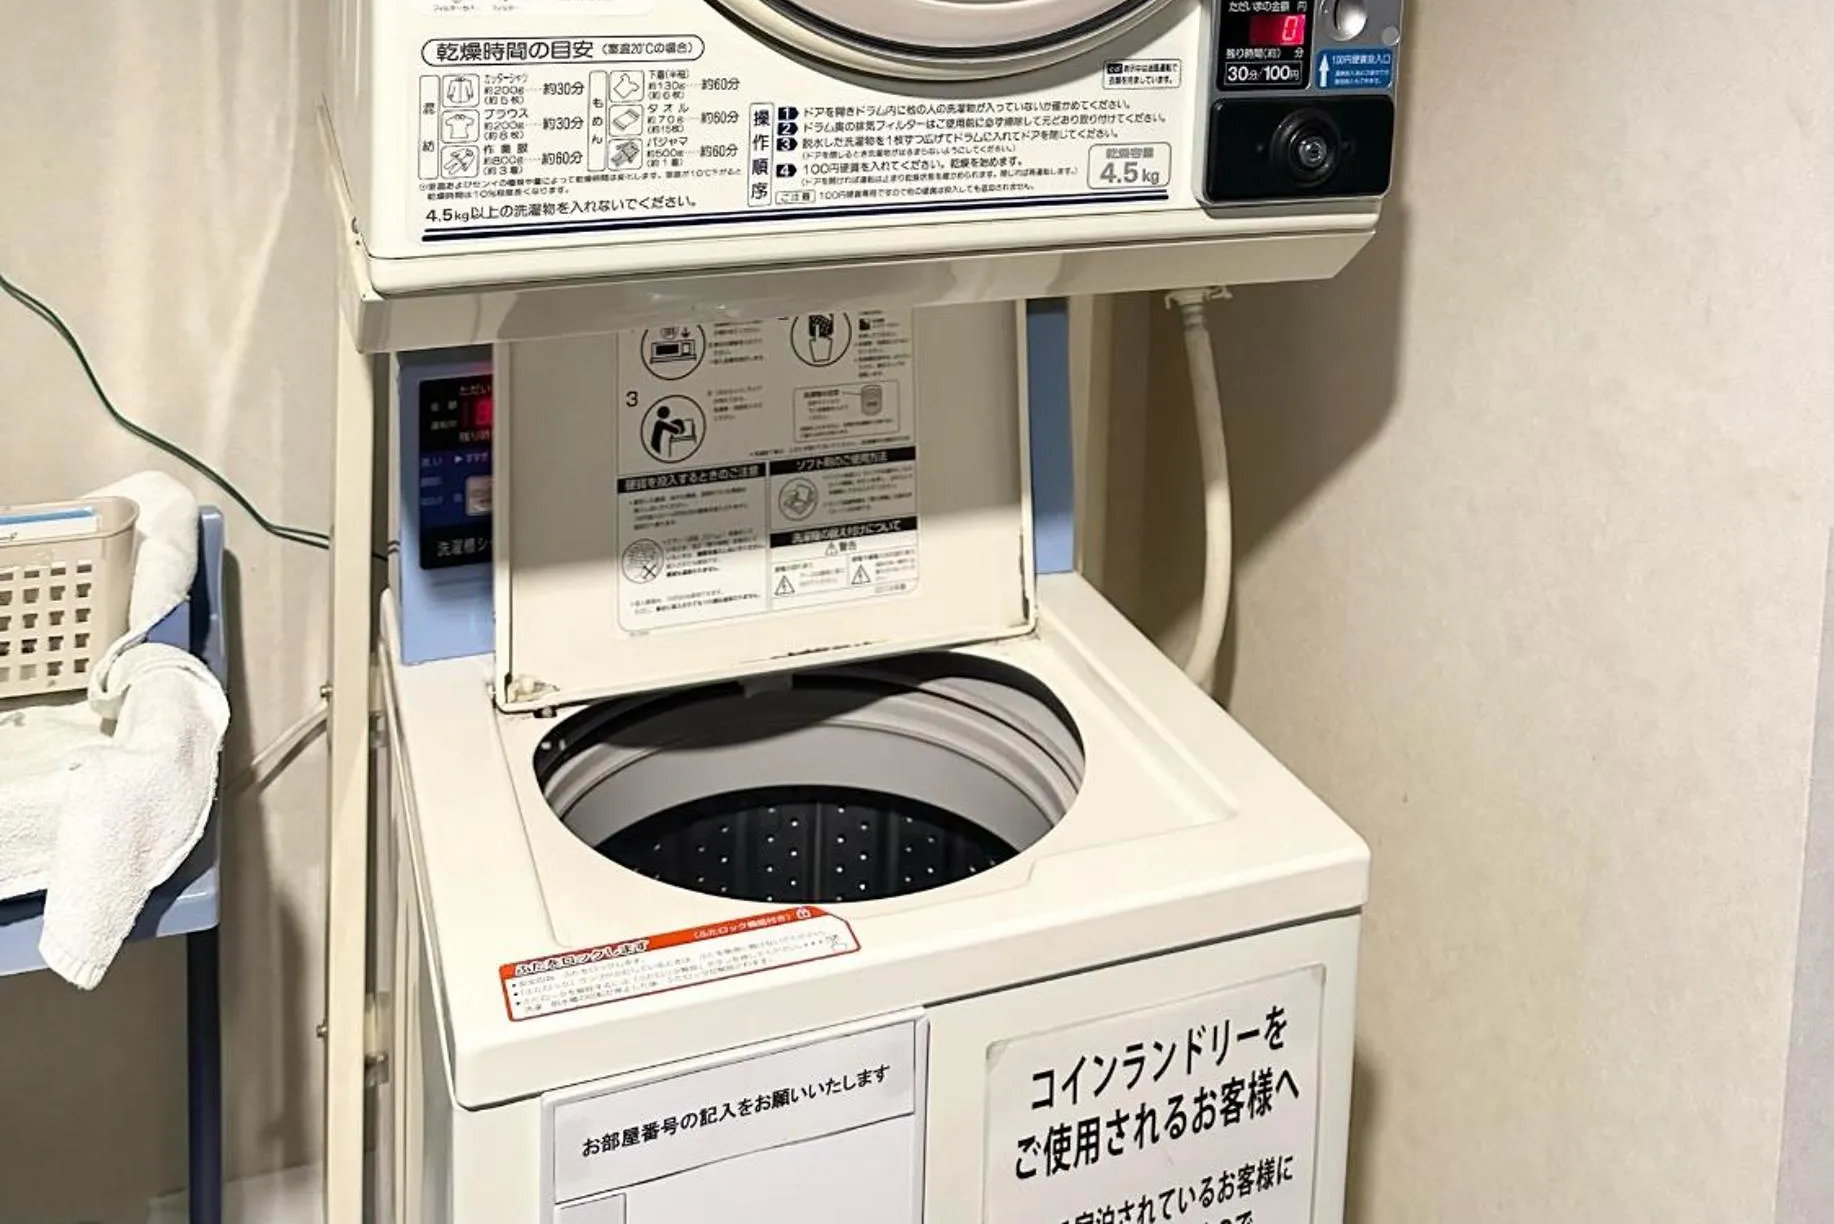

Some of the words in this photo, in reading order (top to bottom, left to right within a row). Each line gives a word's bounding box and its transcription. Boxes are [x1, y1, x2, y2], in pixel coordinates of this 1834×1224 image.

[1296, 0, 1309, 13] 円
[435, 40, 595, 63] 乾燥時間の目安
[1294, 47, 1305, 59] 分
[541, 80, 585, 97] 約30分
[701, 76, 741, 92] 約60分
[541, 114, 585, 131] 約30分
[701, 110, 740, 125] 約60分
[780, 122, 791, 136] 2
[699, 143, 739, 159] 約60分
[780, 137, 791, 152] 3
[541, 150, 584, 167] 約60分
[625, 390, 639, 407] 3
[1031, 1004, 1288, 1111] コインランドリーを
[581, 1063, 891, 1158] お部屋番号の記入をお願いいたします
[1014, 1066, 1300, 1180] ご使用されるお客様へ
[1060, 1155, 1294, 1224] 泊されているお客様に
